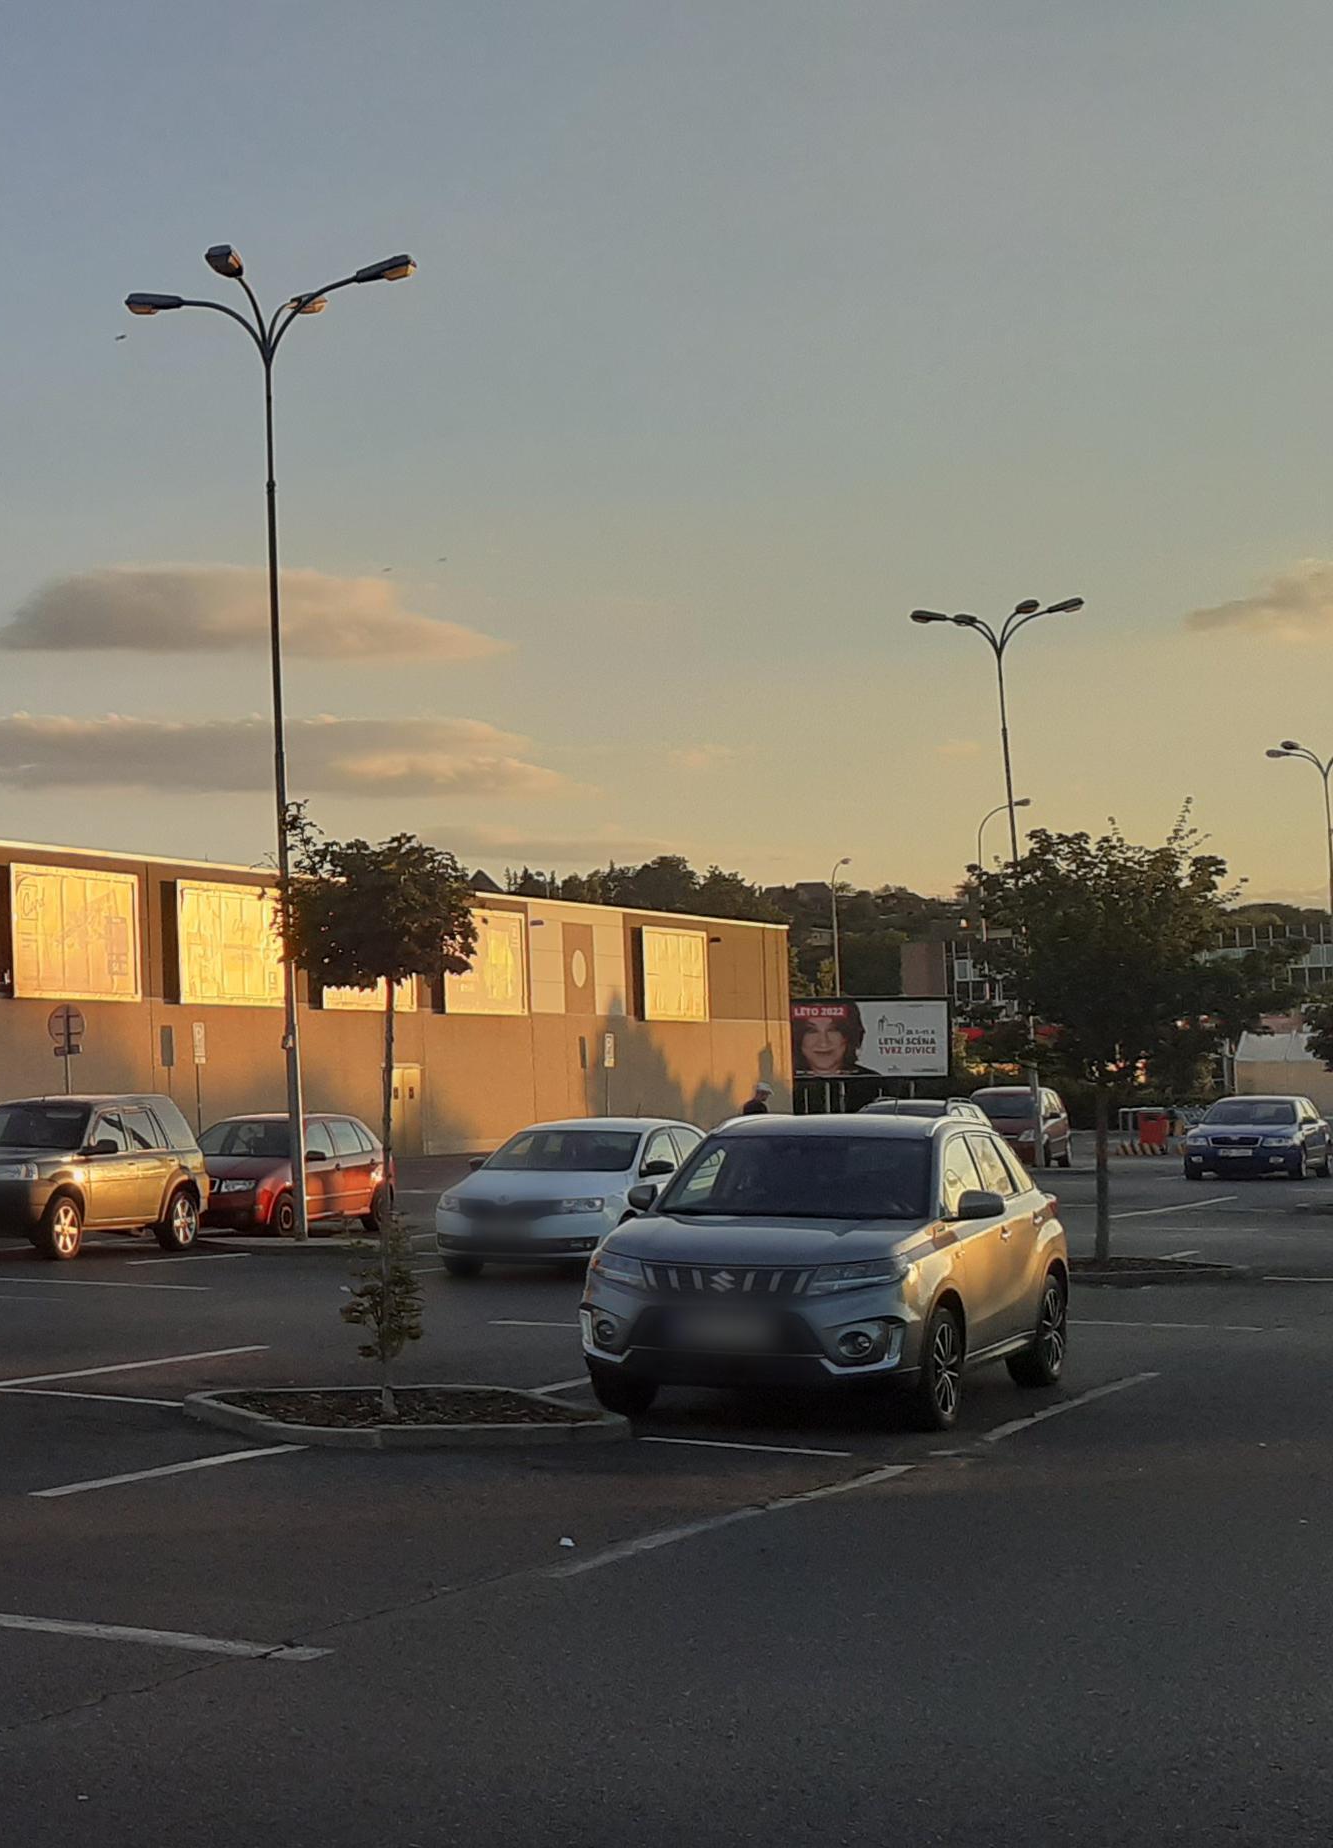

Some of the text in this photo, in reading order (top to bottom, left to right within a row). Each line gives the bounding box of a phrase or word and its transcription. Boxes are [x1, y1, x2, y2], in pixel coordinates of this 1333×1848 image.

[820, 1007, 845, 1016] 2022
[878, 1036, 937, 1046] LETNÍ SCÉNA
[905, 1046, 937, 1055] DIVICE
